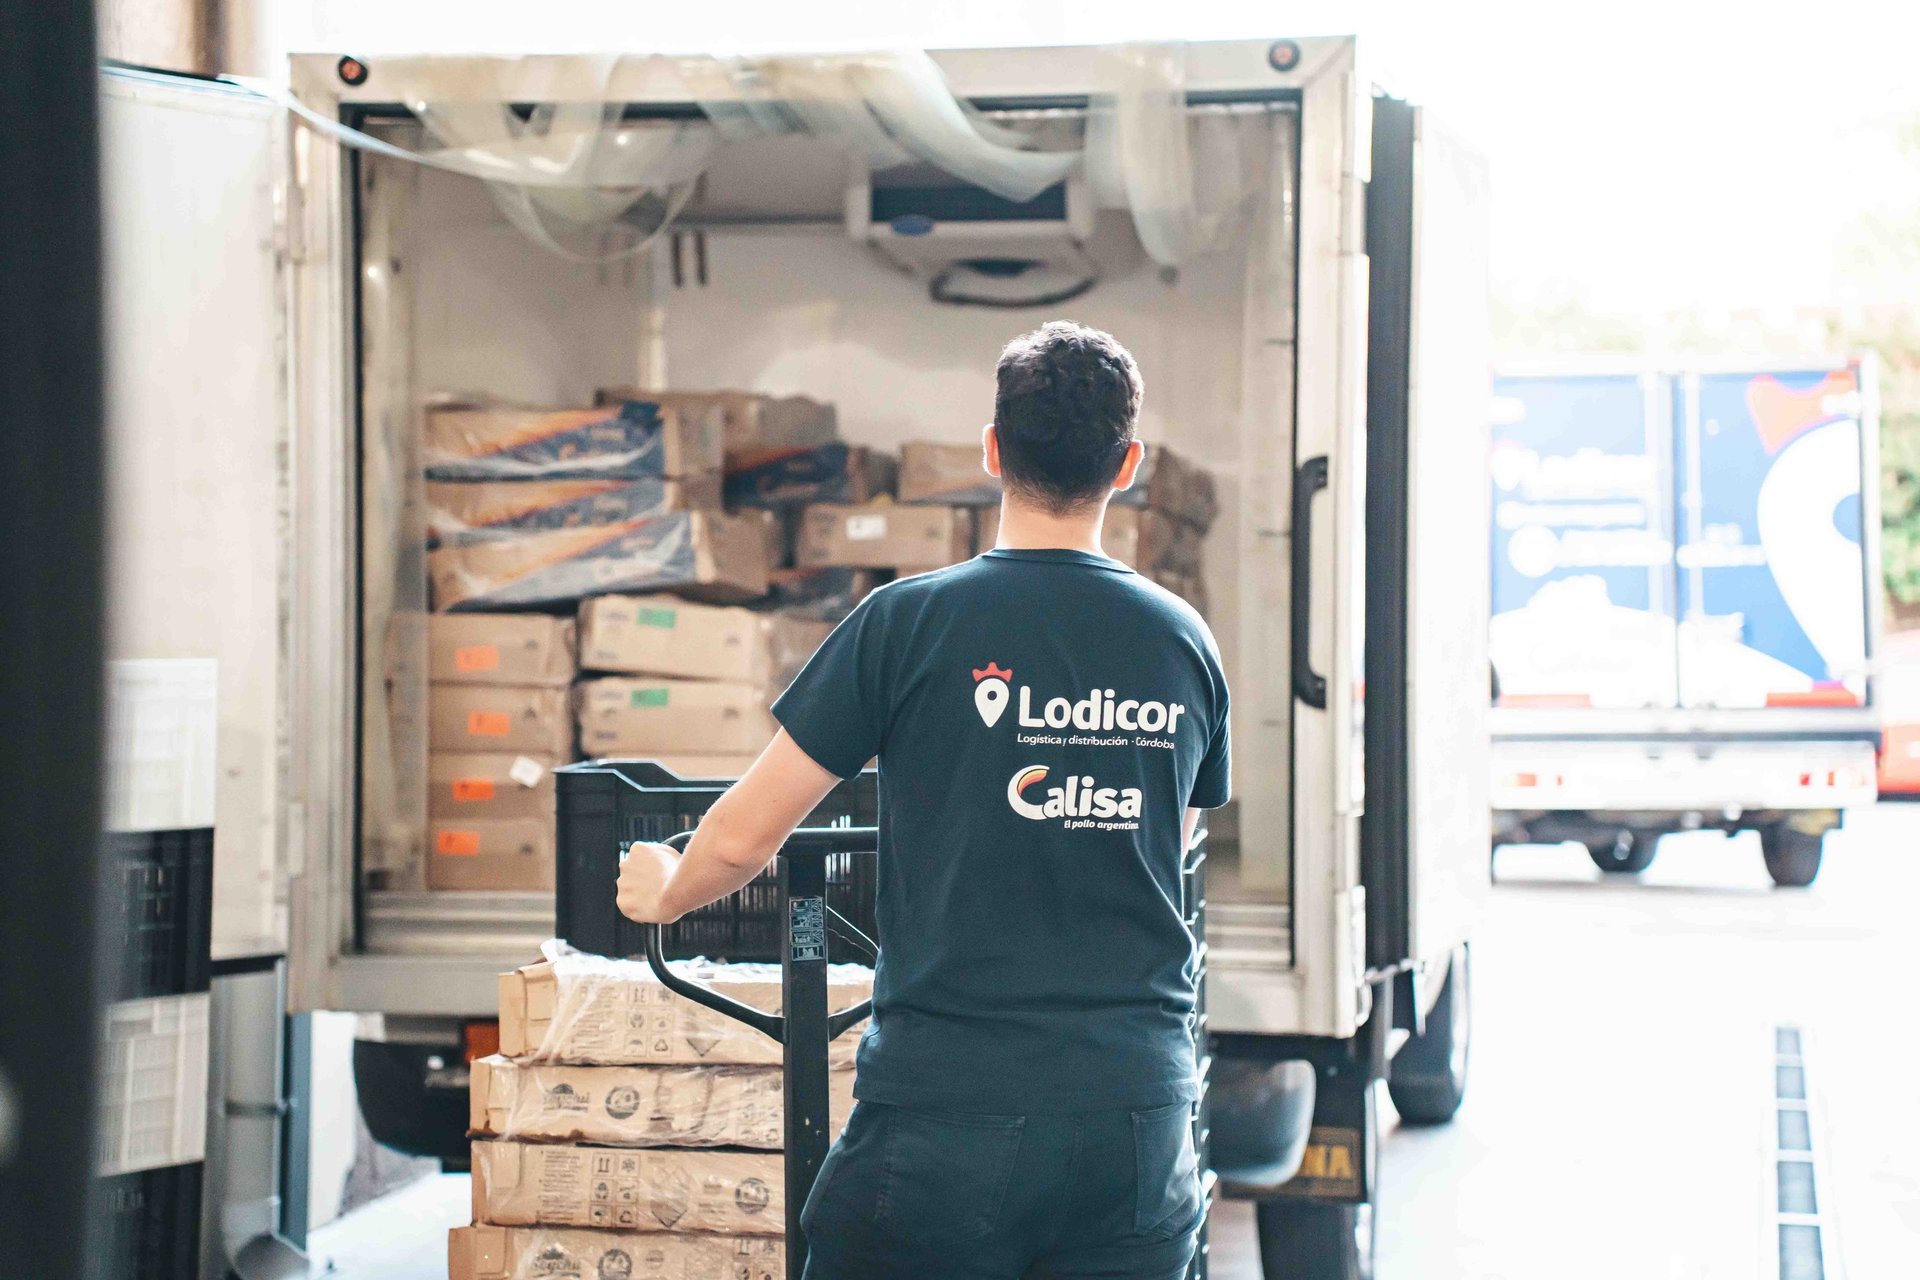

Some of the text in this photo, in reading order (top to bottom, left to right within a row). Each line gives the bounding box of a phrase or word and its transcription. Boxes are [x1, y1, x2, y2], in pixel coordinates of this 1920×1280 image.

[1018, 685, 1185, 734] Lodicor
[1016, 732, 1062, 746] Logística
[1068, 734, 1128, 747] distribución
[1135, 736, 1175, 750] Córdoba
[1007, 764, 1143, 820] Calisa
[1064, 820, 1071, 829] El
[1071, 819, 1095, 830] pollo
